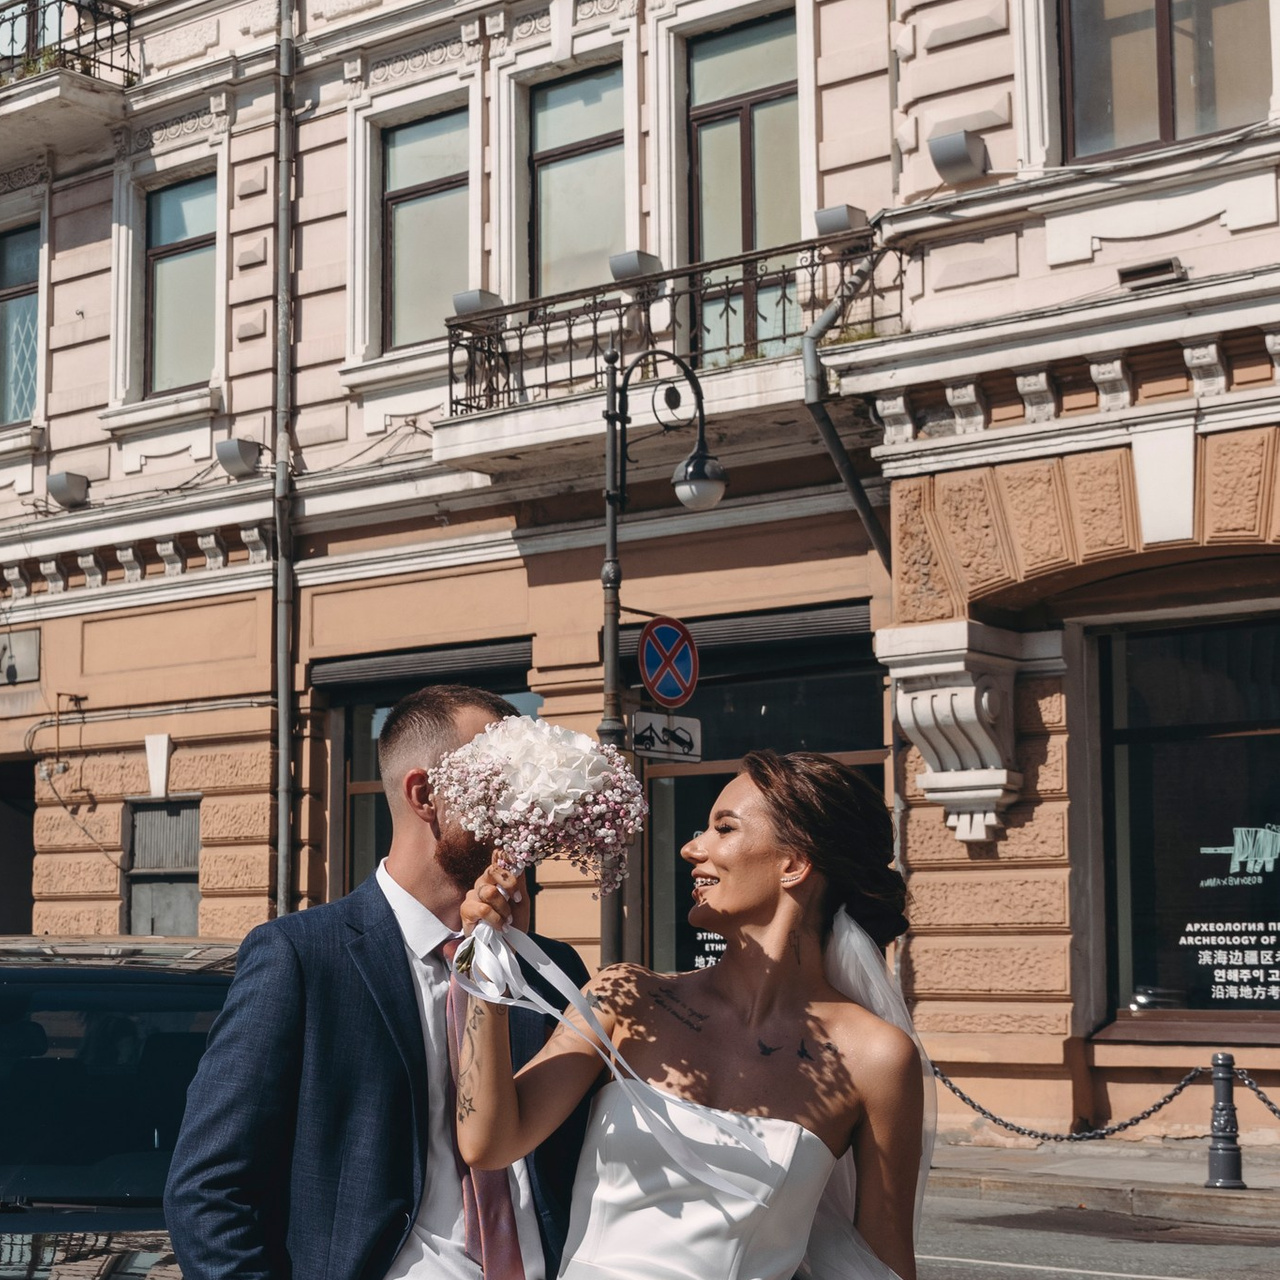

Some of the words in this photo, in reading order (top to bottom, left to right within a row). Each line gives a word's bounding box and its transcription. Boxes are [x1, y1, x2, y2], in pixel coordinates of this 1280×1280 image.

[1185, 922, 1265, 932] АРХЕОЛОГИЯ
[696, 932, 724, 940] ЭТНО
[1179, 935, 1257, 945] ARCHEOLOGY
[1260, 935, 1277, 945] OF
